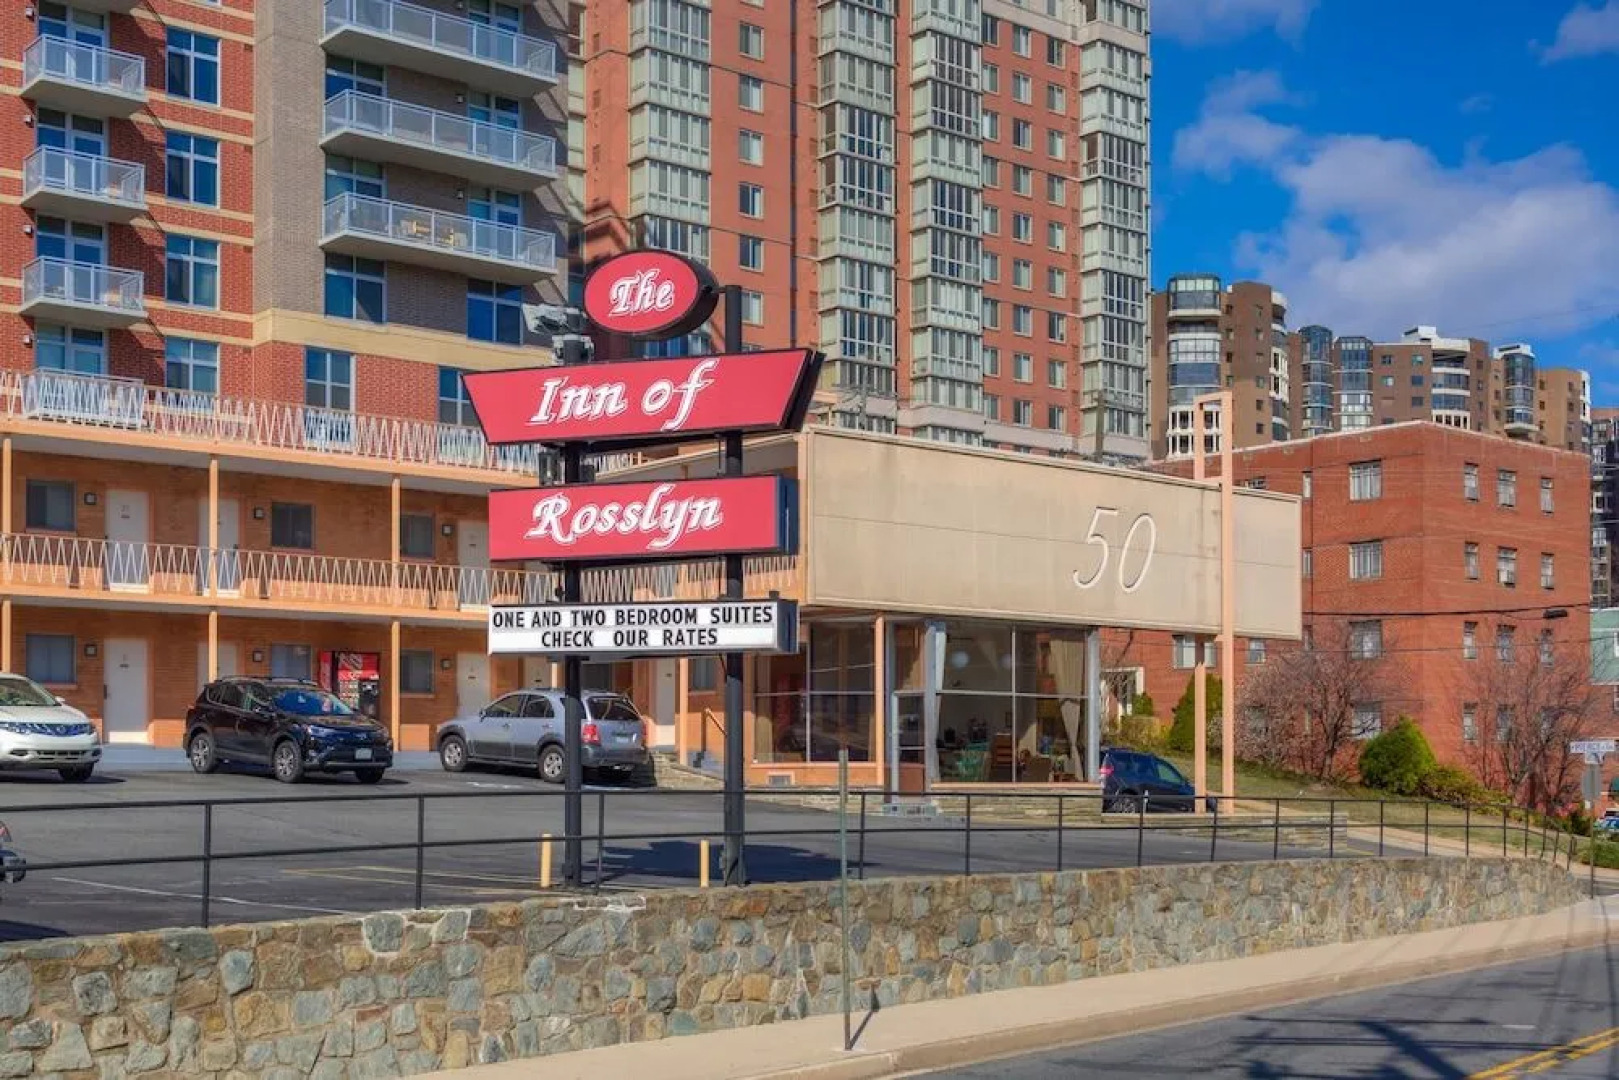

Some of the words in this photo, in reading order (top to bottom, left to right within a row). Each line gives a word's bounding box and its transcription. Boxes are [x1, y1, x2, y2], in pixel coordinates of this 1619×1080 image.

[609, 269, 674, 316] The
[527, 376, 628, 425] Inn
[641, 357, 720, 431] of
[524, 483, 723, 550] Rosslyn
[1072, 505, 1157, 593] 50
[493, 611, 525, 628] ONE
[531, 610, 562, 628] AND
[570, 609, 606, 626] TWO
[615, 608, 698, 626] BEDROOM
[710, 606, 773, 624] SUITES
[541, 630, 594, 647] CHECK
[613, 629, 649, 647] OUR
[662, 628, 718, 646] RATES
